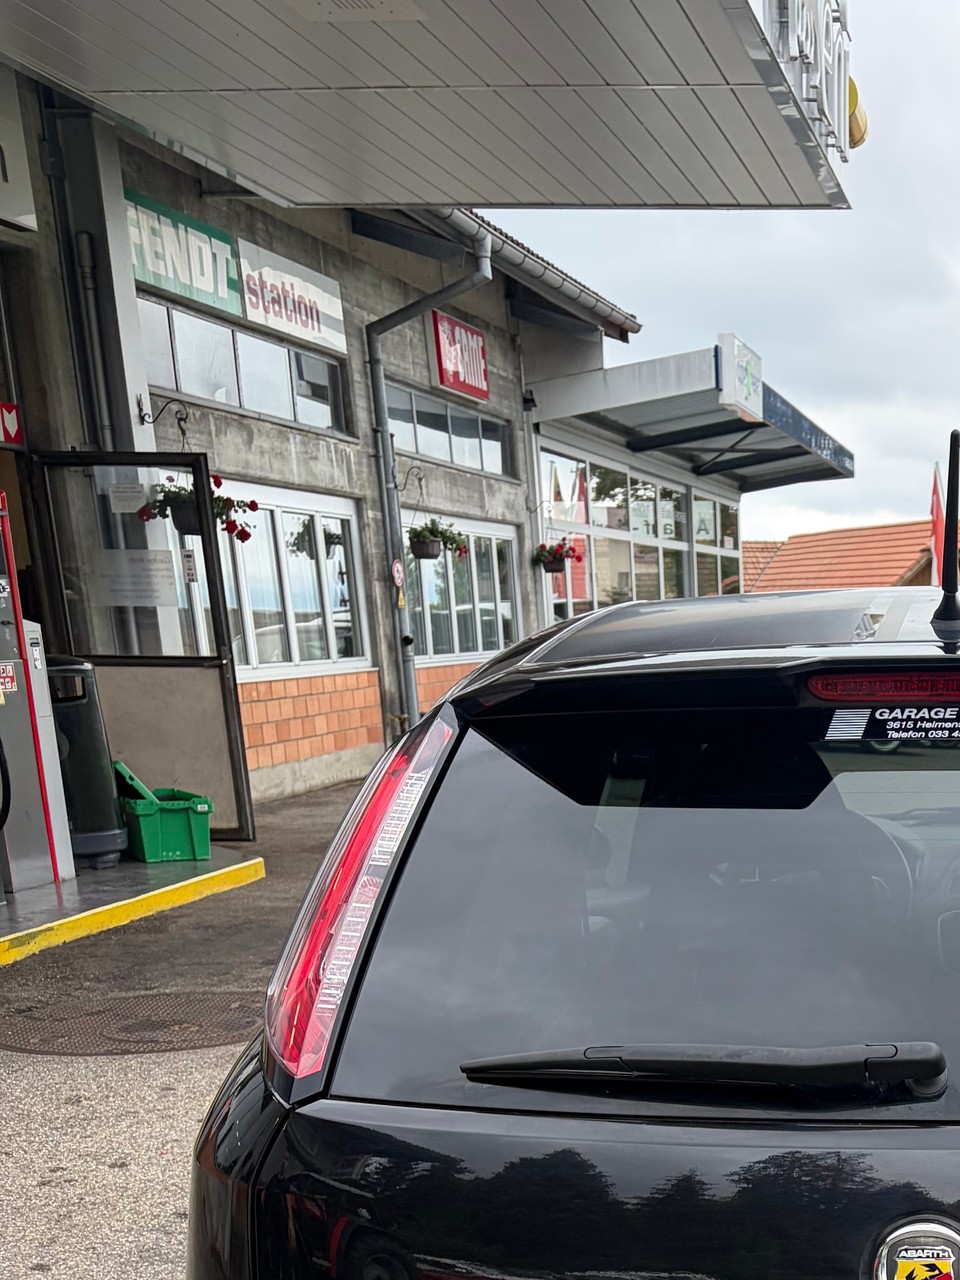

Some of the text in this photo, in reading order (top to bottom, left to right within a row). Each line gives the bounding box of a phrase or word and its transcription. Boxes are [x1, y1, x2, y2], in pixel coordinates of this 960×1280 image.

[126, 200, 322, 333] FENDT station
[875, 708, 959, 720] GARAGE
[886, 721, 914, 729] 3615
[886, 730, 926, 739] Telefon
[928, 730, 950, 738] 033
[899, 1249, 949, 1258] ABARTH
